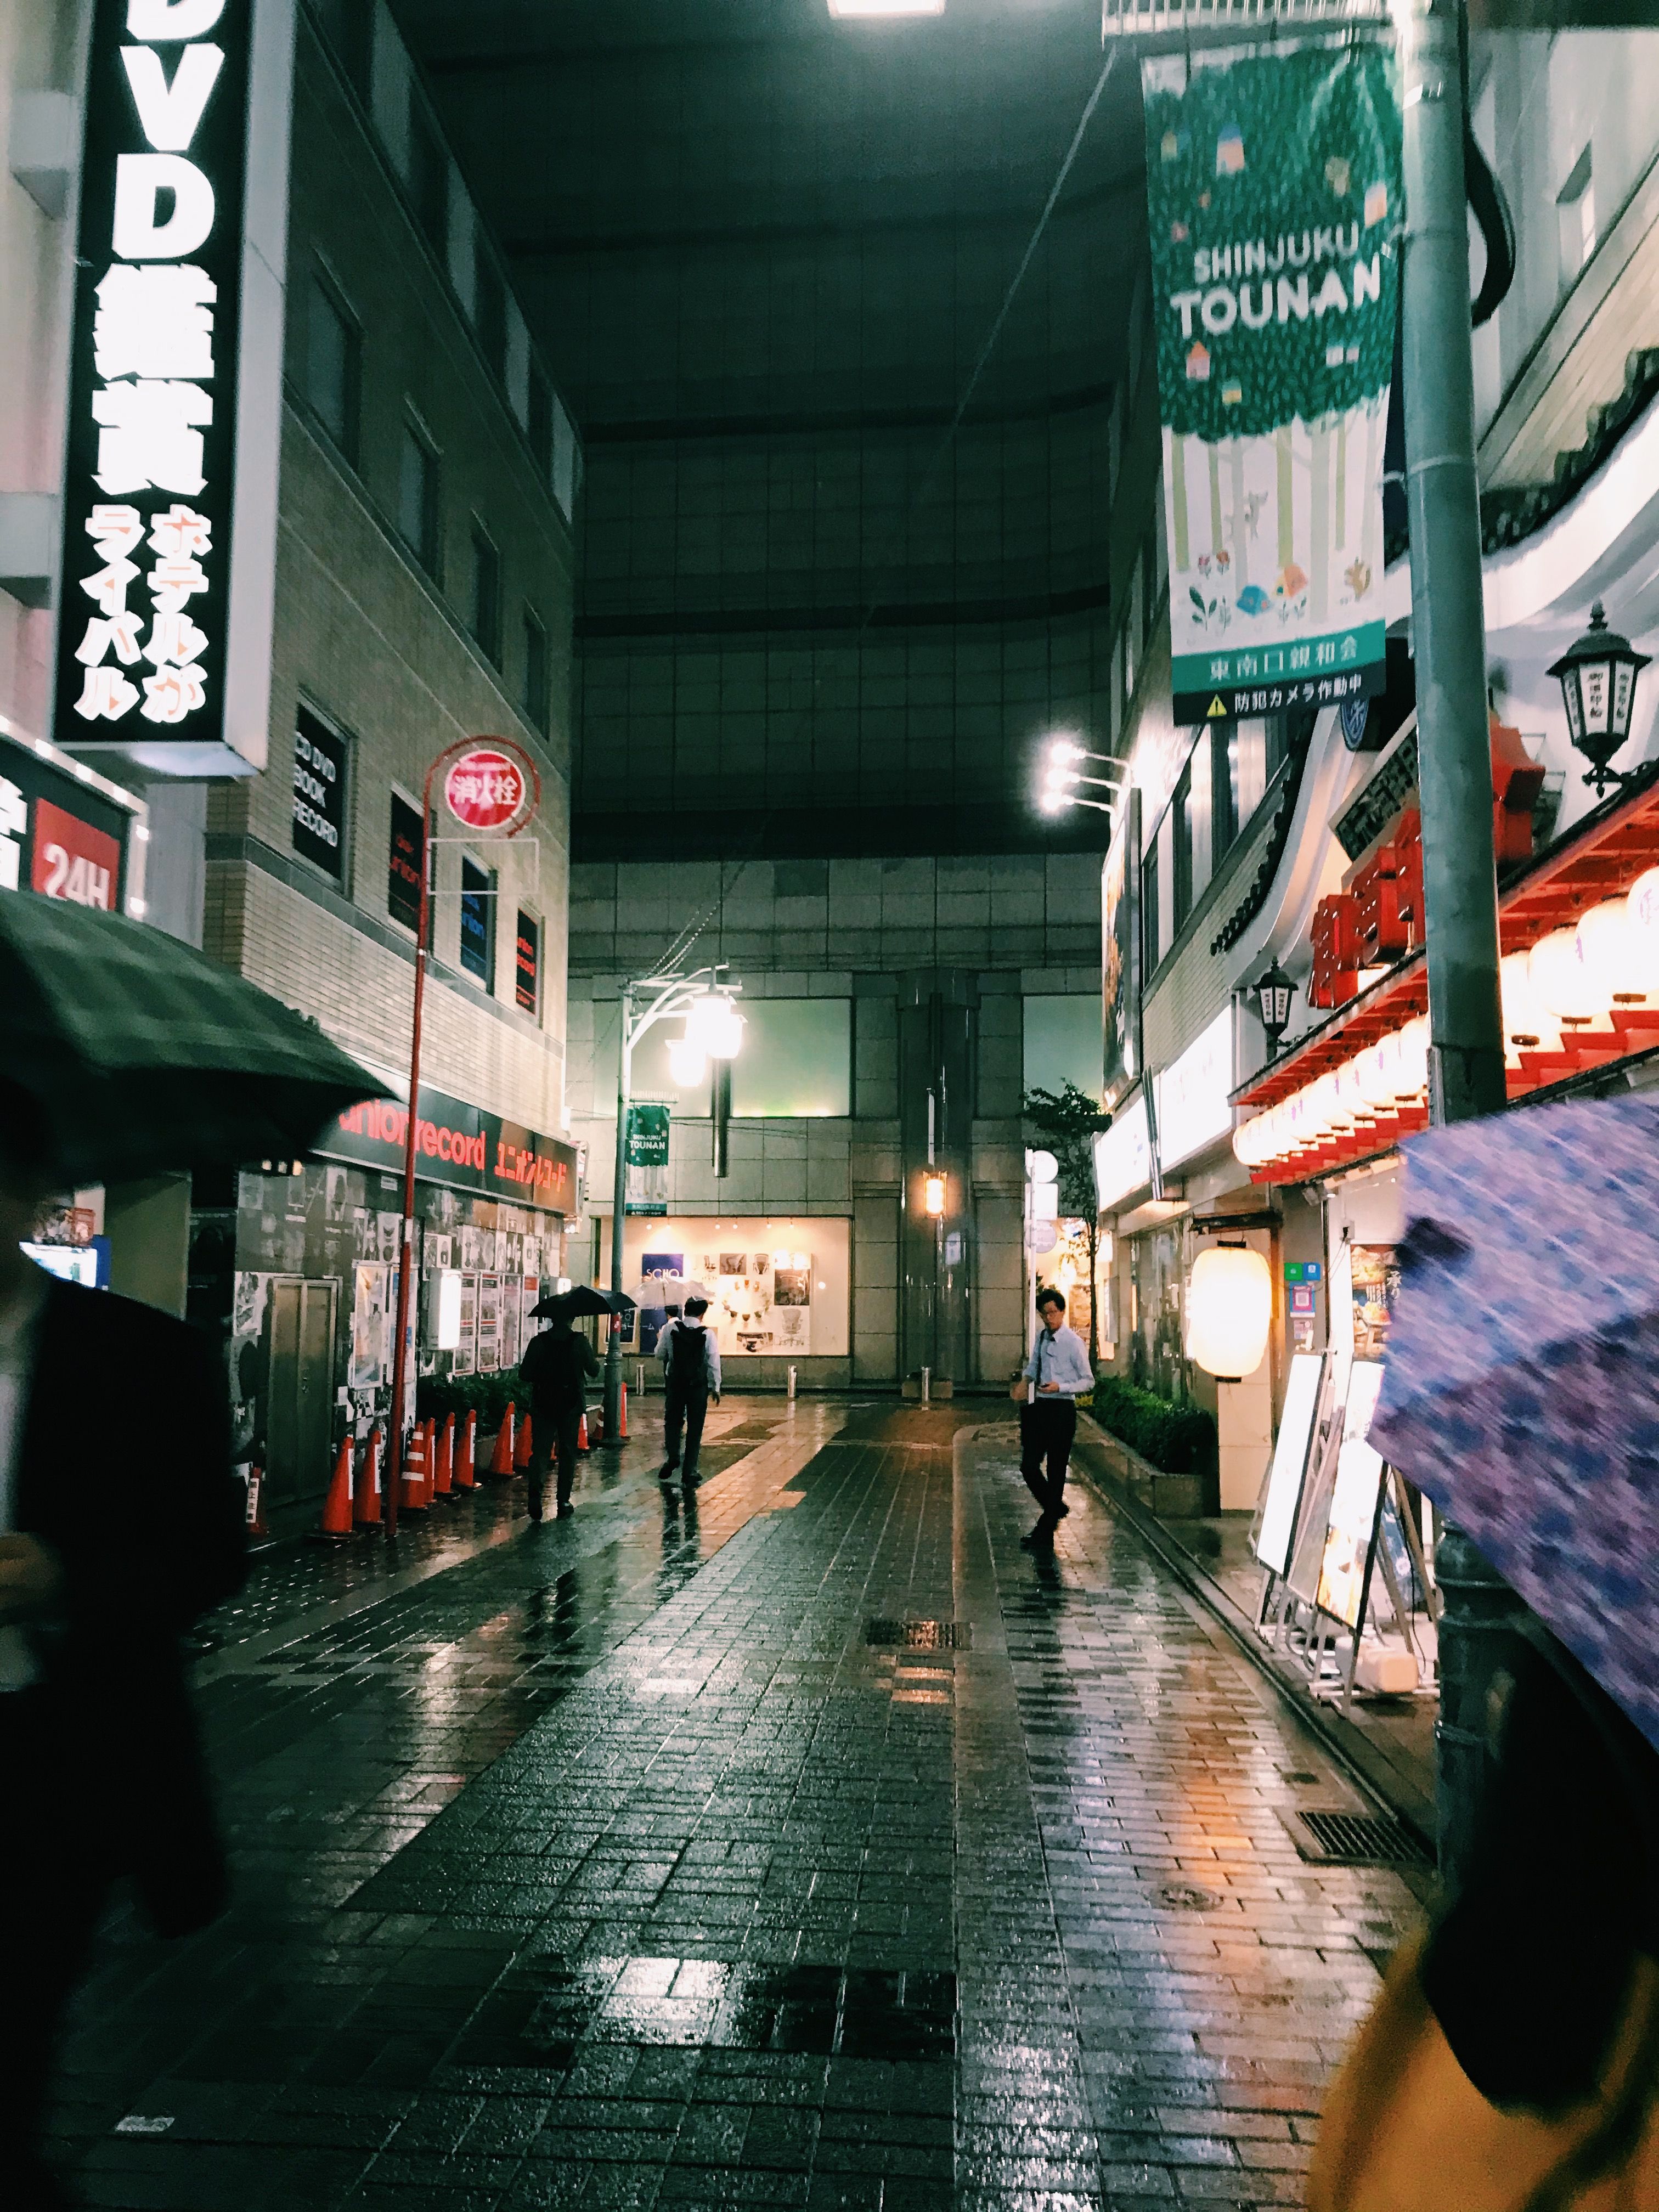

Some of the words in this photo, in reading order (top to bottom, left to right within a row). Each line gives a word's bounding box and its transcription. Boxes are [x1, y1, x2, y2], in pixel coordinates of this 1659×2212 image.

[1194, 220, 1359, 284] SHINJUKU
[1170, 252, 1380, 339] TOUNAN
[74, 504, 145, 721] ライバル
[140, 504, 213, 723] ホテルが
[1210, 635, 1357, 681] 東南口親和会
[1235, 673, 1362, 713] 防犯カメラ作動中
[295, 731, 311, 761] CD
[312, 746, 336, 782] DVD
[294, 763, 326, 809] BOOK
[454, 773, 518, 805] 消火栓
[293, 795, 338, 848] RECORD
[43, 842, 110, 911] 24H
[494, 1142, 567, 1192] ユニオンレコード
[629, 1141, 665, 1150] TOUNAN
